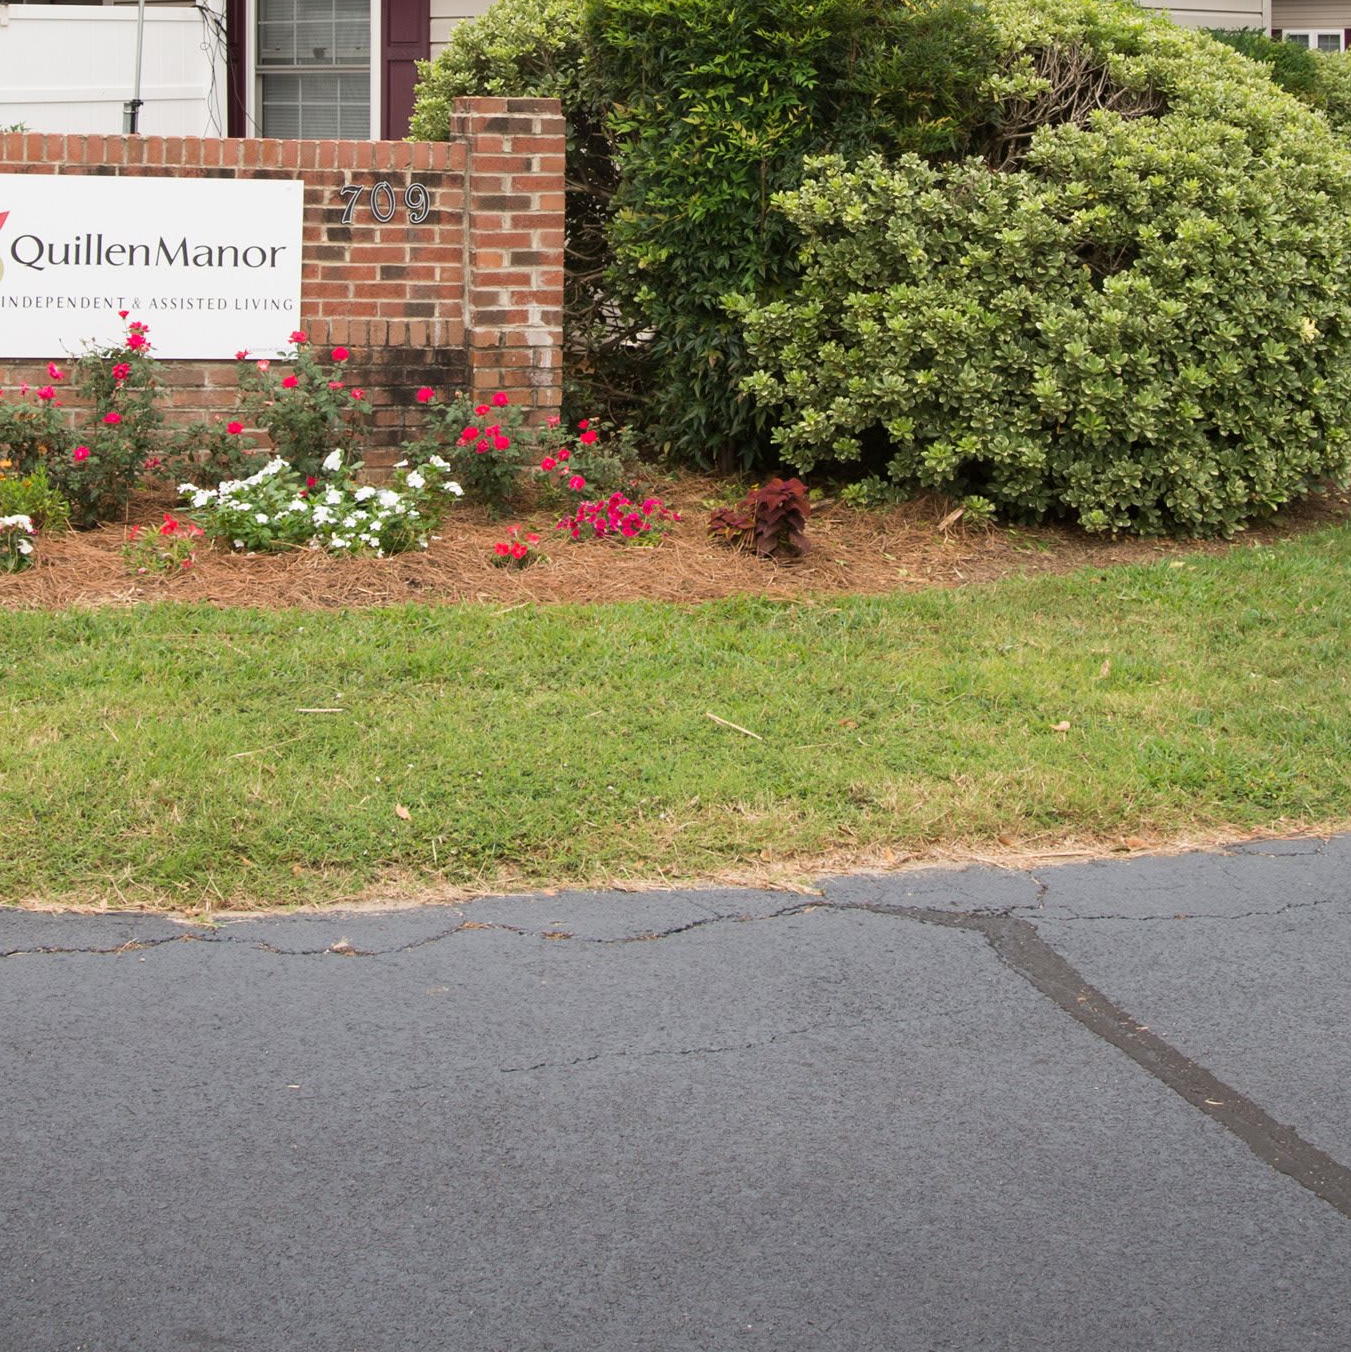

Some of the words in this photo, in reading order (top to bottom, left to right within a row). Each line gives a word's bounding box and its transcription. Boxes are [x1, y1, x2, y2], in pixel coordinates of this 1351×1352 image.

[340, 181, 430, 224] 709
[1, 295, 125, 309] INDEPENDENT
[131, 297, 142, 309] &
[149, 297, 227, 310] ASSISTED
[235, 298, 293, 311] LIVING
